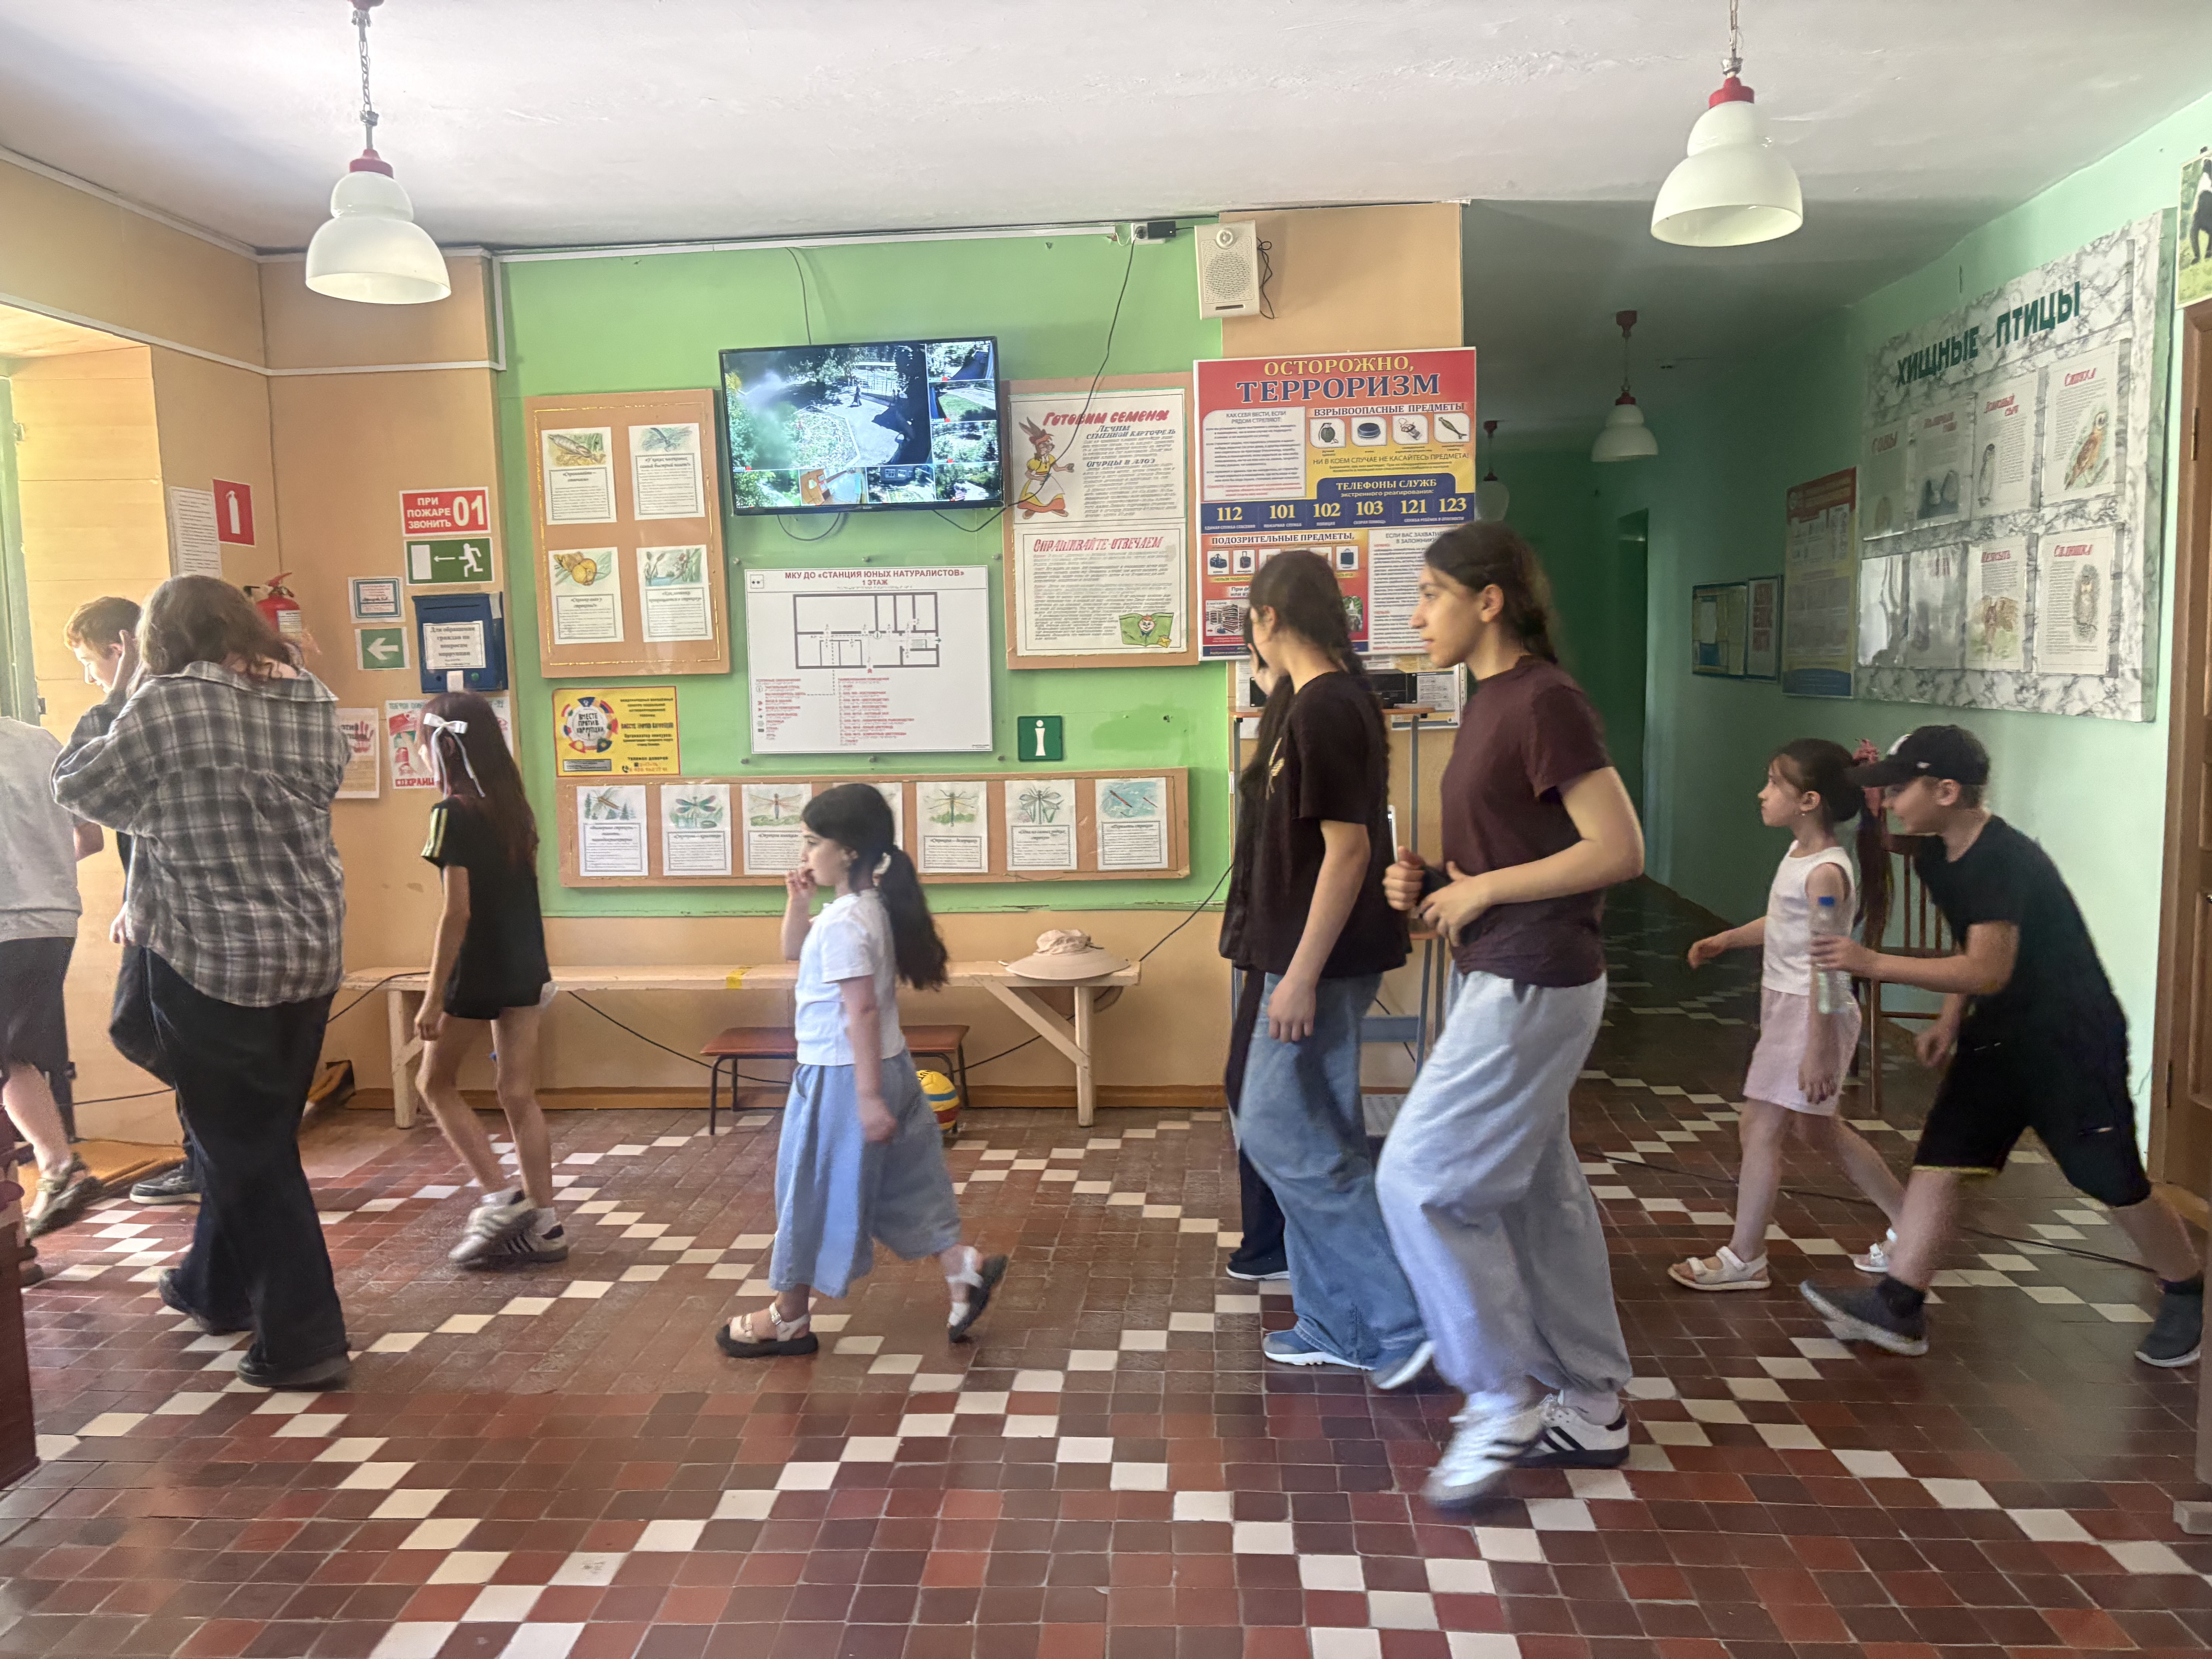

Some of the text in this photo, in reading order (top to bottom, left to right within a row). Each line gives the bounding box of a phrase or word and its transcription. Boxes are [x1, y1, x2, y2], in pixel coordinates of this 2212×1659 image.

[1897, 281, 2081, 387] ХИЩНЫЕ ПТИЦЫ
[1264, 356, 1414, 376] ОСТОРОЖНО,
[1236, 373, 1441, 403] ТЕРРОРИЗМ
[1314, 403, 1465, 416] ВЗРЫВООПАСНЫЕ ПРЕДМЕТЫ
[1336, 479, 1437, 491] ТЕЛЕФОНЫ СЛУЖБ
[417, 497, 439, 506] ПРИ
[1356, 500, 1383, 515] 103
[1400, 499, 1427, 514] 121
[1439, 497, 1467, 512] 123
[407, 508, 452, 518] ПОЖАРЕ
[453, 495, 484, 527] 01
[1217, 507, 1243, 521] 112
[1269, 504, 1295, 519] 101
[1313, 503, 1341, 518] 102
[408, 519, 452, 529] ЗВОНИТЬ
[1212, 532, 1355, 544] ПОДОЗРИТЕЛЬНЫЕ ПРЕДМЕТЫ,
[893, 569, 965, 577] НАТУРАЛИСТОВ»
